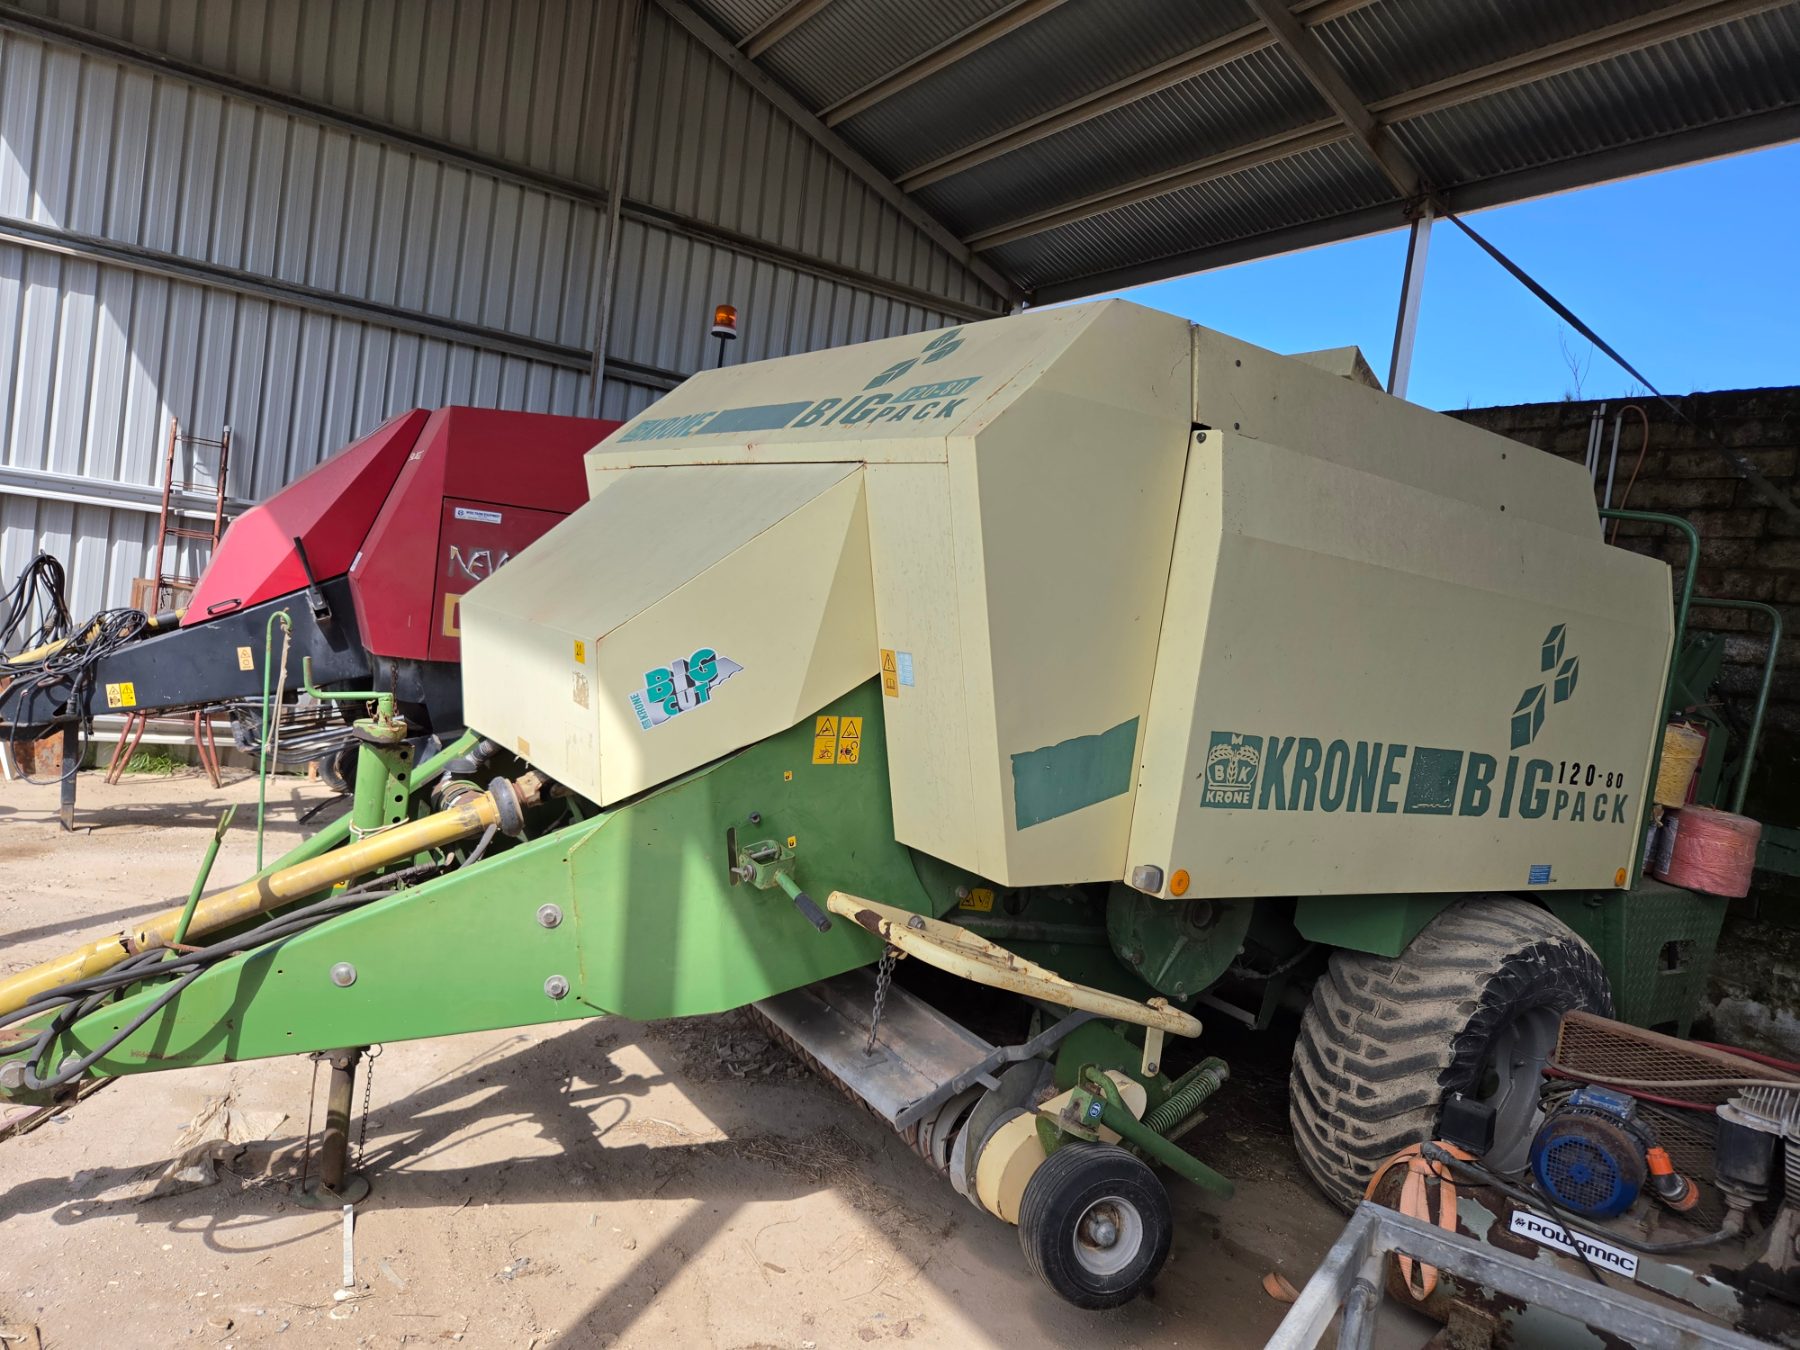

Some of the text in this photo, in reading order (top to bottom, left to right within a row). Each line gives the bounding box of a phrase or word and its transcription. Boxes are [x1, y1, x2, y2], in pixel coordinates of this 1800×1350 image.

[790, 392, 896, 429] BIG
[867, 398, 969, 425] PACK
[645, 648, 719, 703] BIG
[629, 692, 649, 721] KRONE
[662, 681, 711, 716] CUT
[1257, 736, 1628, 824] KRONE BIG PACK
[1557, 761, 1624, 789] 120-80
[1205, 790, 1251, 804] KRONE
[1527, 1220, 1635, 1272] POWAMAC
